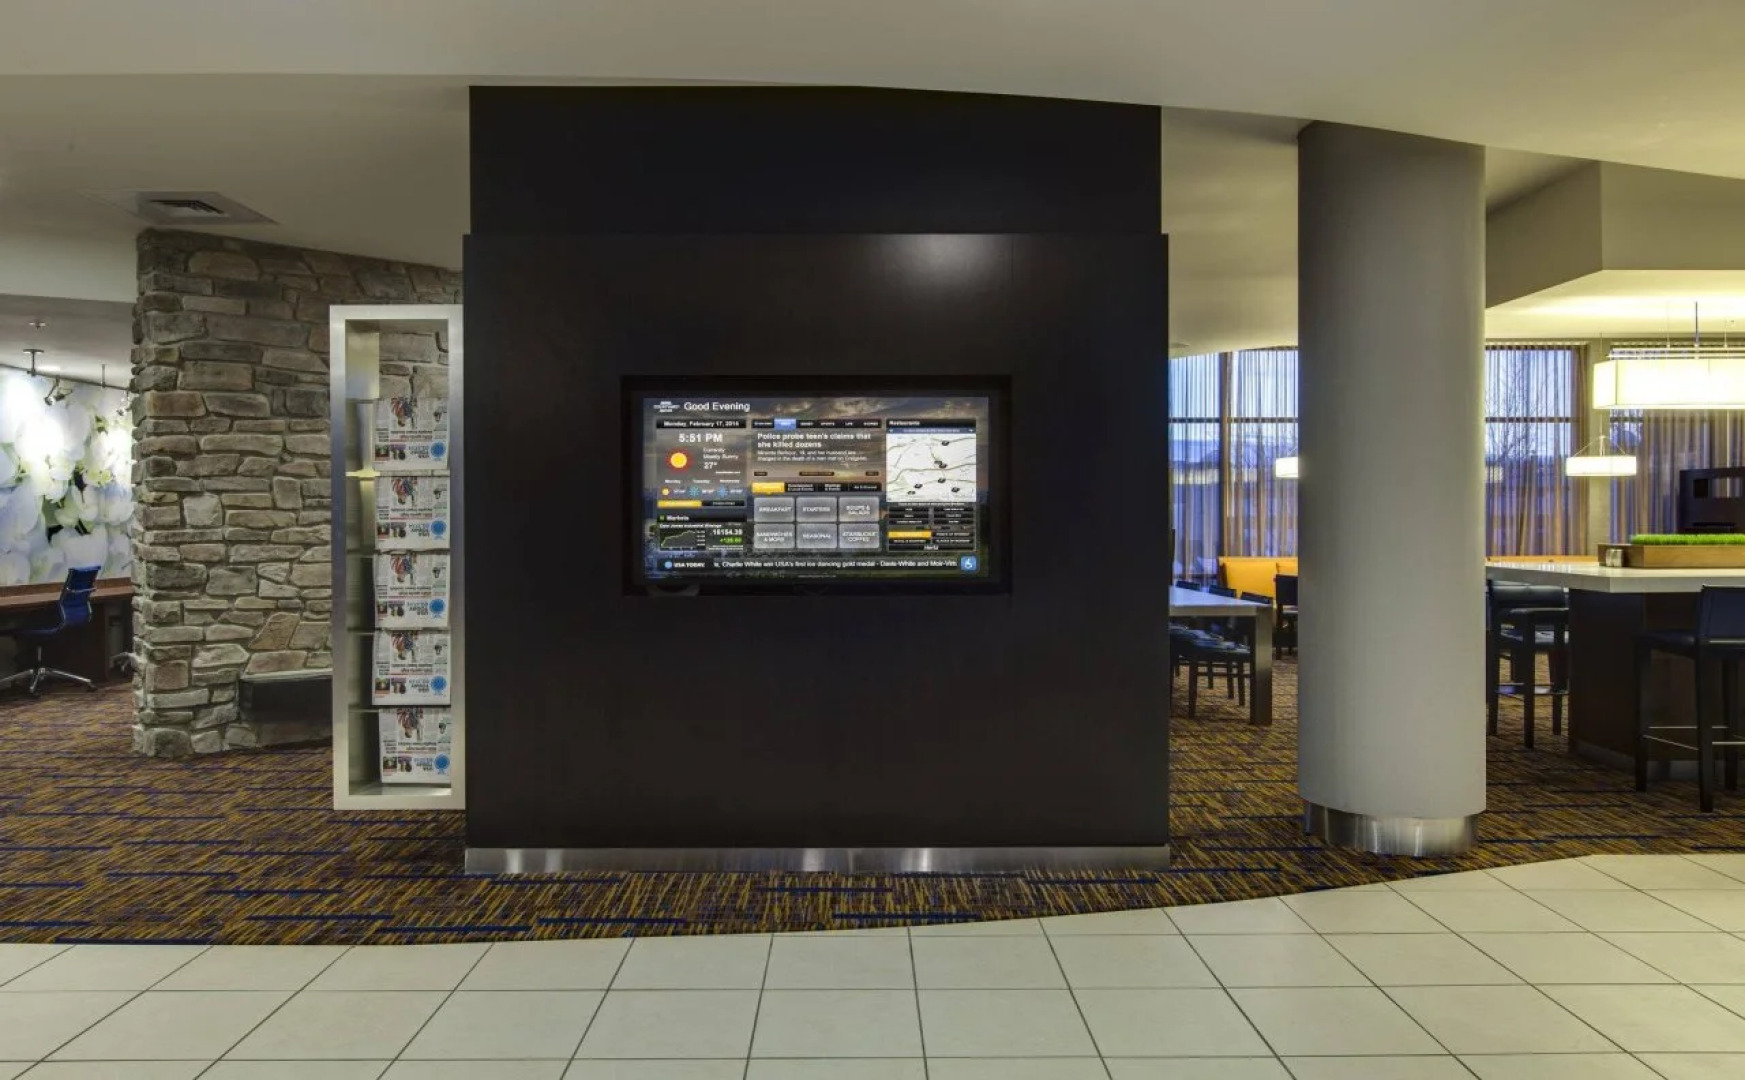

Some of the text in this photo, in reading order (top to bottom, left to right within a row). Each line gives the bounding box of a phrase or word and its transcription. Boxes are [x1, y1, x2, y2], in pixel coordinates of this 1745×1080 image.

[683, 401, 710, 411] Good
[712, 401, 750, 413] Evening
[689, 420, 715, 428] February
[678, 433, 723, 443] 5:51 PM
[757, 432, 871, 442] Police probe teen's claims that
